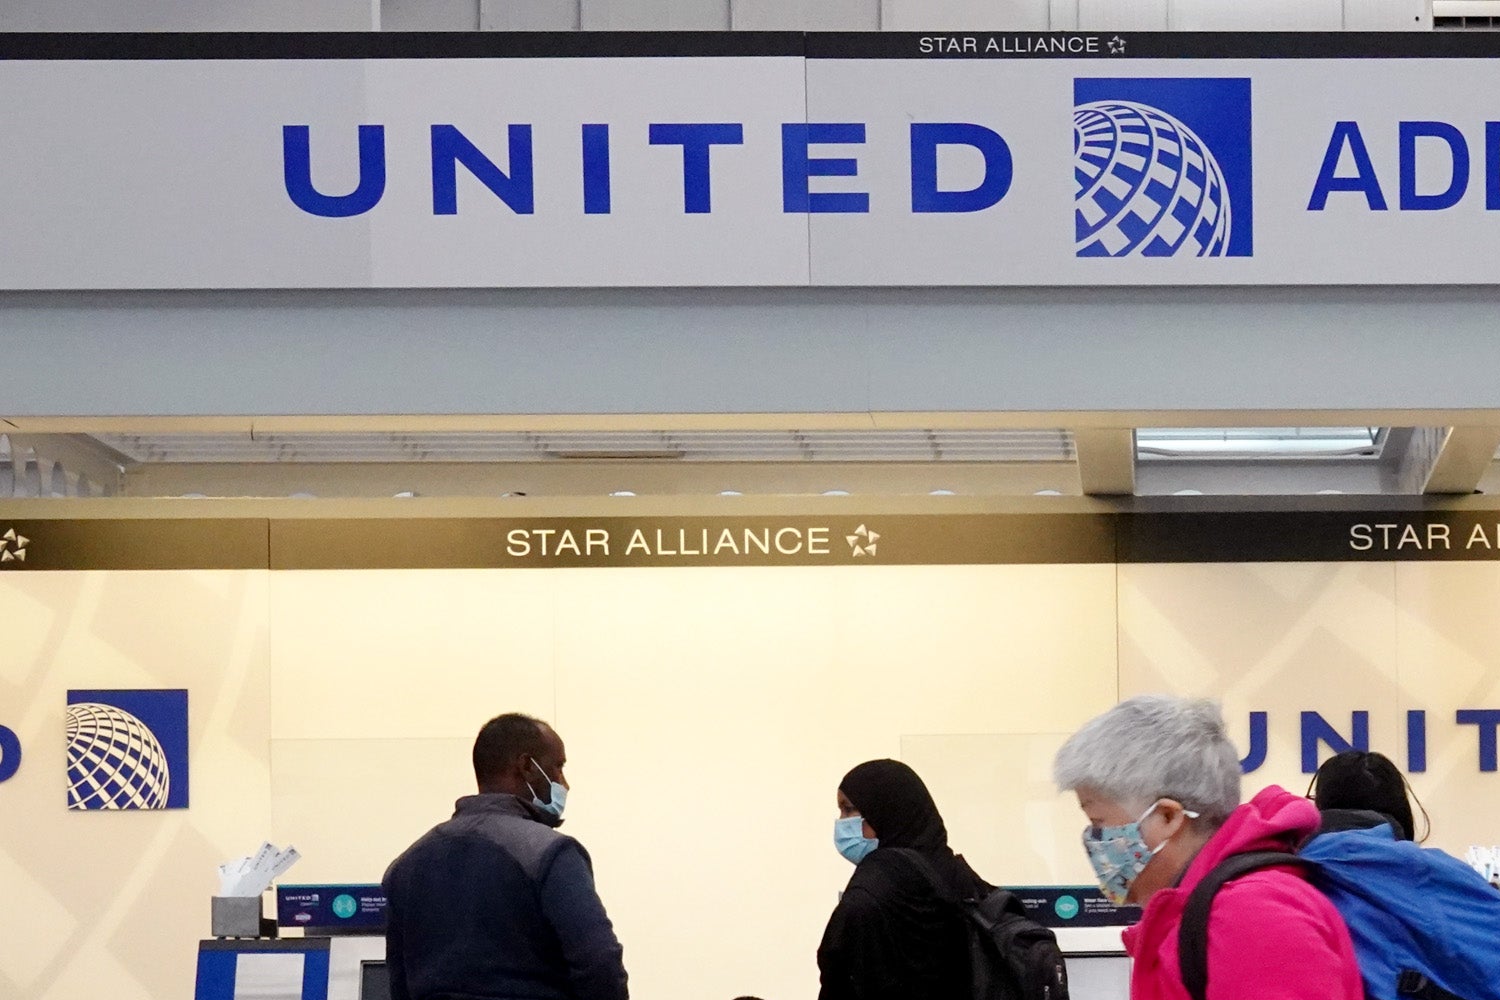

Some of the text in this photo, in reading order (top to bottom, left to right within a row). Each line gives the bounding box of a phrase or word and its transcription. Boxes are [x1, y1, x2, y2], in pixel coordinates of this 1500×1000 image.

[919, 37, 1100, 53] STAR ALLIANCE
[283, 123, 1013, 217] UNITED
[506, 526, 832, 558] STAR ALLIANCE
[1349, 522, 1452, 551] STAR
